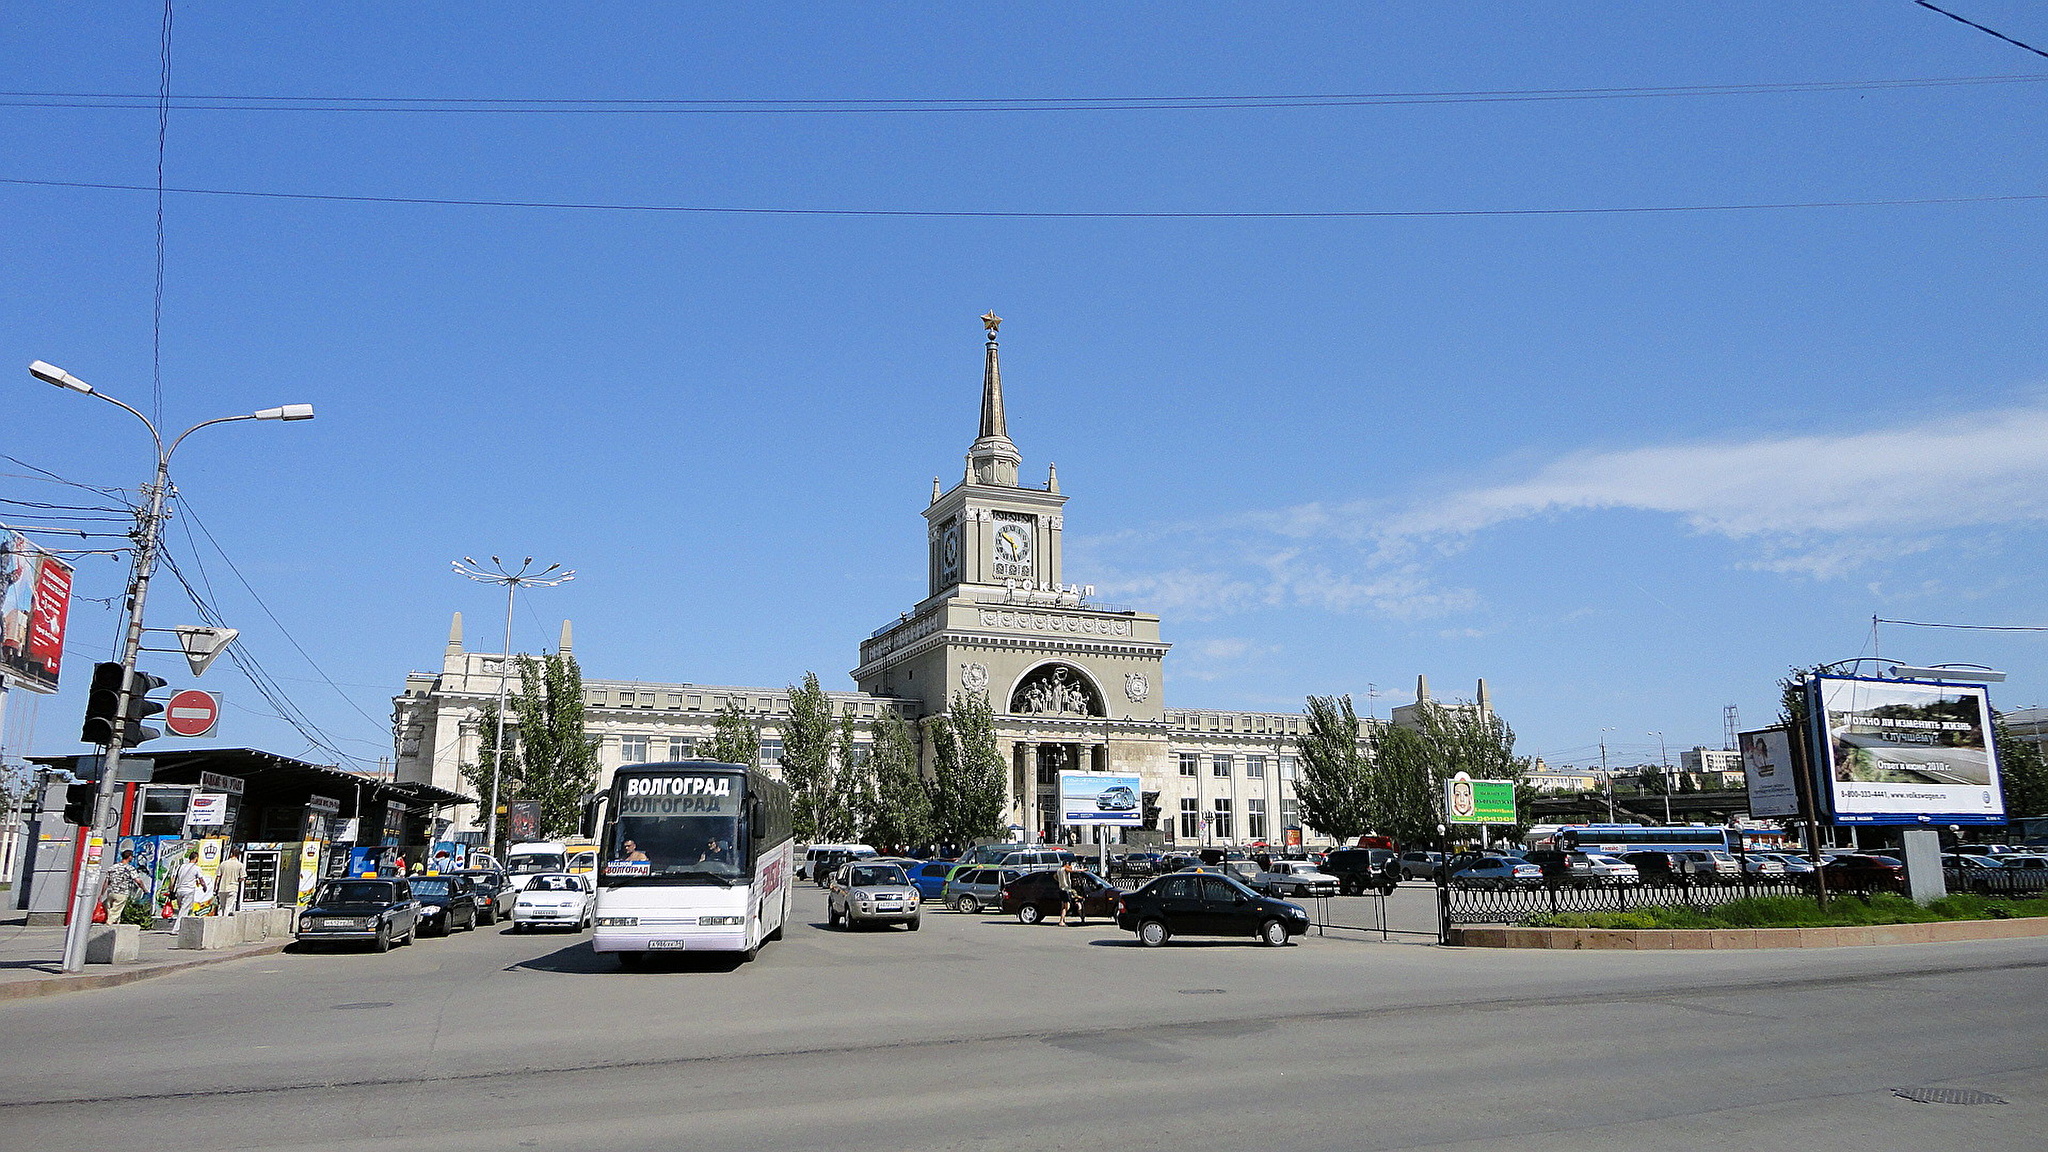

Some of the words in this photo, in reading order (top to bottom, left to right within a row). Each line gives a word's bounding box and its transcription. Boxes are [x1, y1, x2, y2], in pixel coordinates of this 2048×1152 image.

[1007, 580, 1095, 596] ВОКЗАЛ
[1843, 712, 1879, 726] Можно
[1881, 717, 1893, 728] ли
[1894, 718, 1940, 731] изменить
[1941, 721, 1972, 732] жизнь
[1889, 731, 1940, 745] лучшему?
[1877, 760, 1899, 770] Ответ
[1927, 762, 1944, 771] 2010
[627, 777, 730, 796] ВОЛГОГРАД
[1890, 792, 1947, 801] www.volkswagen.ru
